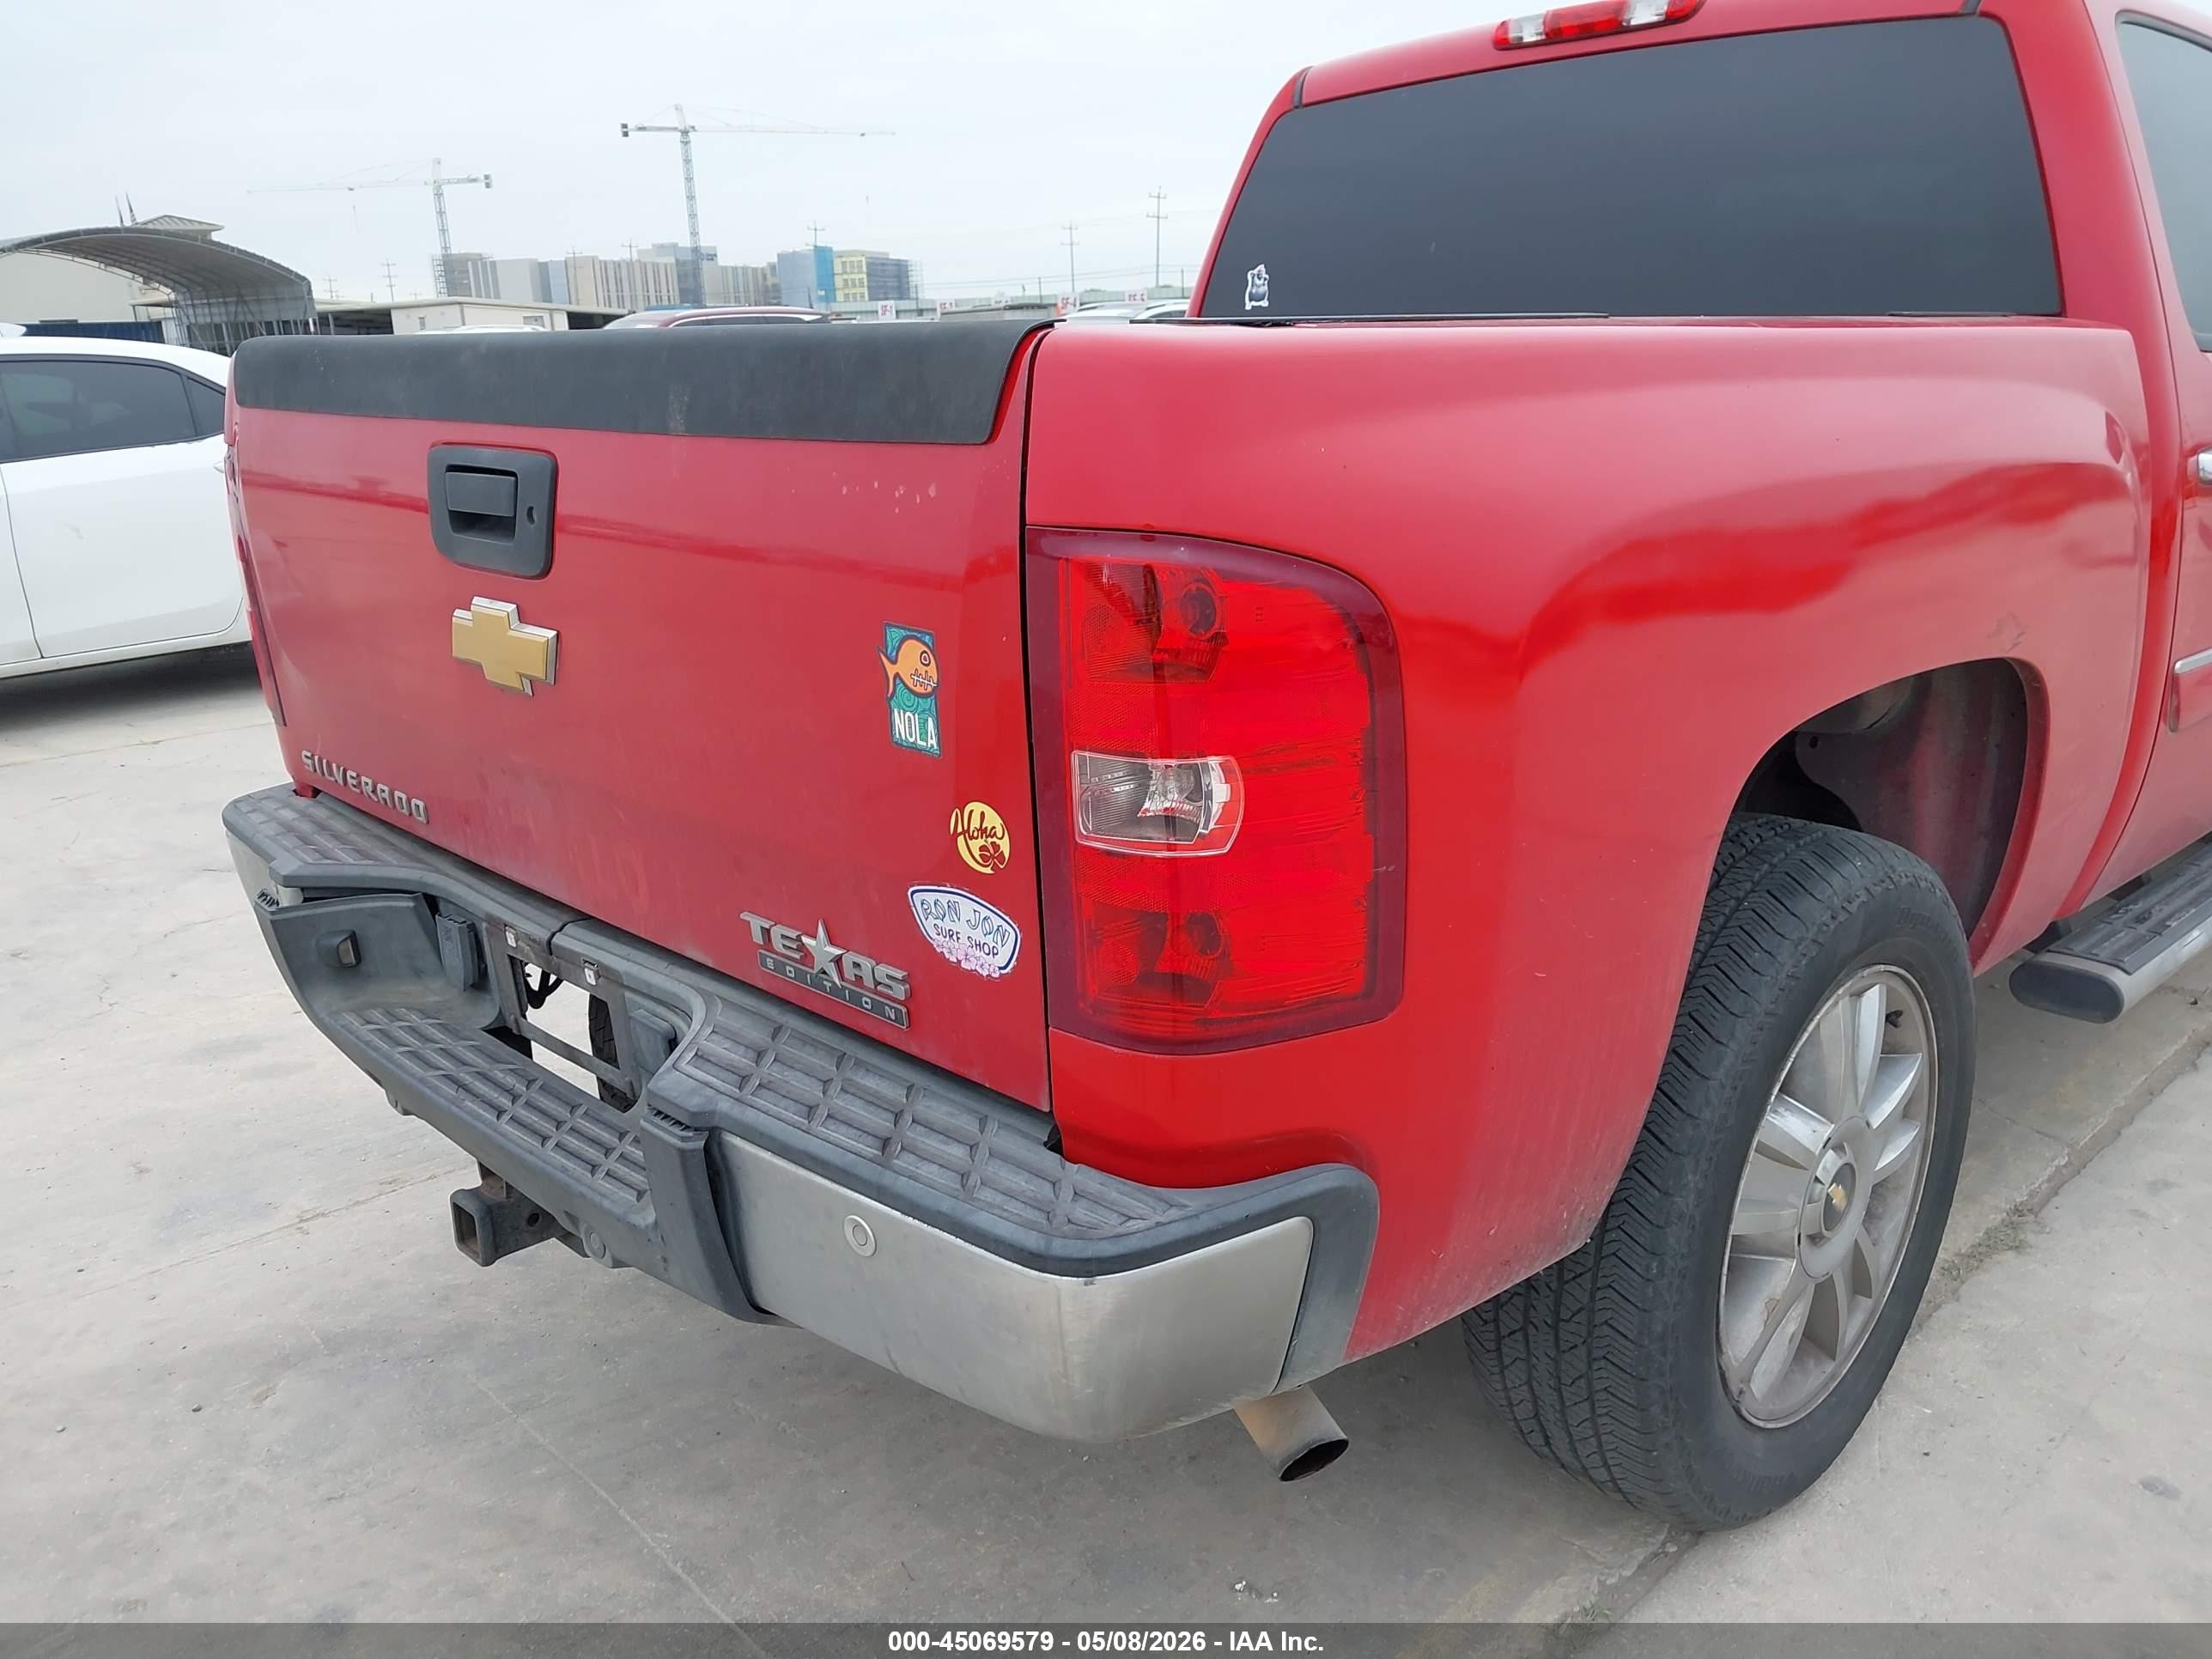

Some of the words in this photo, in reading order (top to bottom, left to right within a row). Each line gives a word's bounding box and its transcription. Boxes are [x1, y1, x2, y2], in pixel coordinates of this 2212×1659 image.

[893, 708, 938, 750] NOLA
[301, 750, 429, 825] SILVERADO
[951, 808, 1006, 848] Aloha
[921, 898, 961, 923] RON
[966, 908, 1011, 947] JON
[933, 923, 962, 944] SURF
[968, 938, 1000, 958] SHOP
[765, 957, 897, 1021] EDITION
